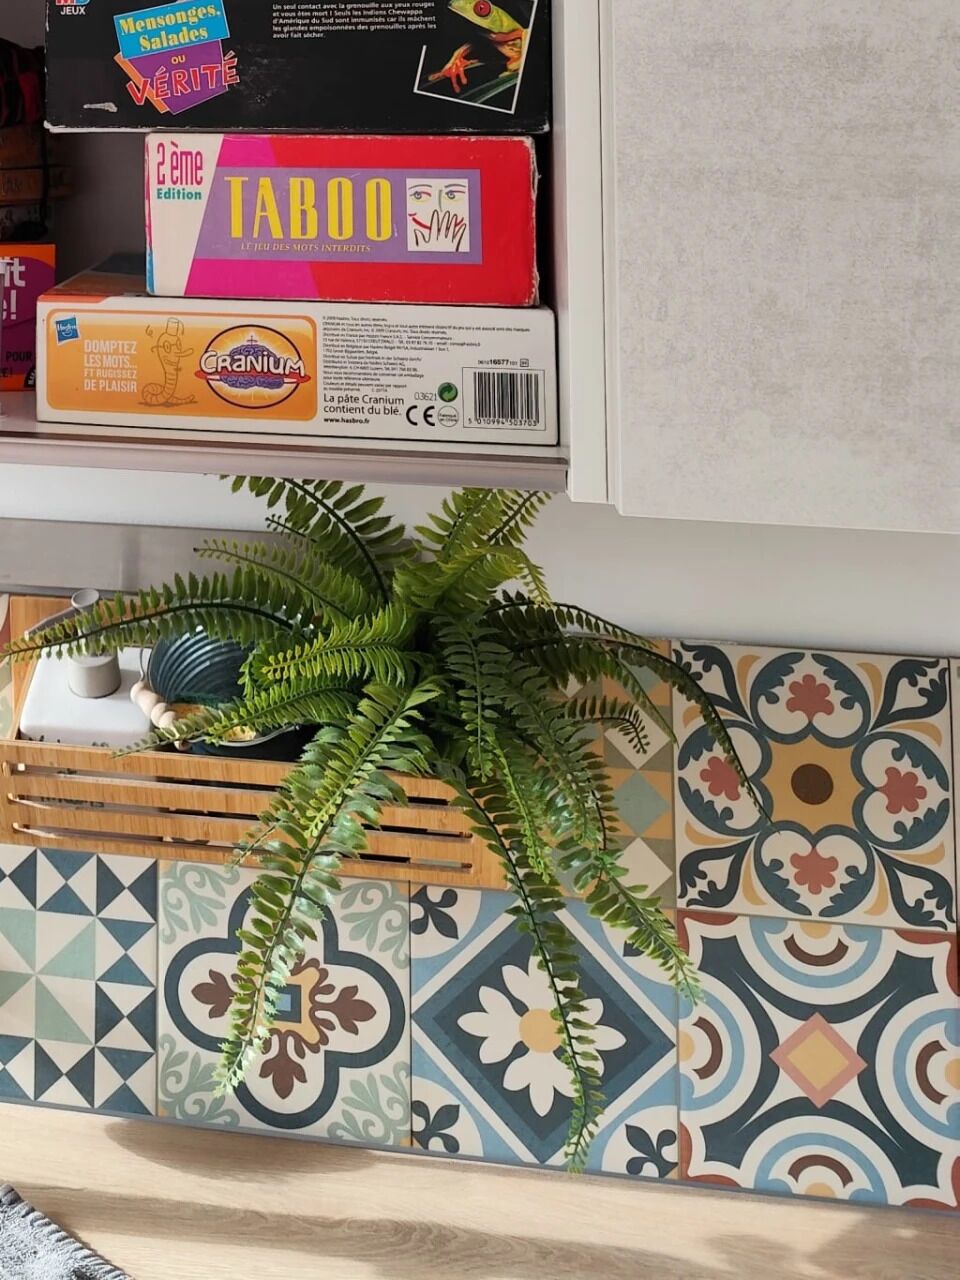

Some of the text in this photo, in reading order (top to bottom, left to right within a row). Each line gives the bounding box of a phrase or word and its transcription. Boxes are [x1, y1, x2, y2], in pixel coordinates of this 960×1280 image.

[60, 6, 86, 16] JEUX
[346, 2, 379, 10] grenouille
[411, 1, 435, 9] rouges
[139, 26, 208, 52] Salades
[126, 50, 241, 106] VÉRITÉ
[157, 140, 203, 186] 2 ème
[156, 187, 202, 200] Edition
[224, 176, 393, 242] TABOO
[241, 242, 371, 252] LE JEU DES MOTS INTERDITS
[84, 340, 137, 354] DOMPTEZ
[5, 351, 33, 362] POUR
[84, 355, 138, 369] LES MOTS...
[96, 370, 137, 379] RUGISSEZ
[84, 380, 138, 393] DE PLAISIR
[323, 393, 405, 405] La pâte Cranium
[414, 391, 438, 402] 03621
[323, 405, 402, 416] contient du blé.
